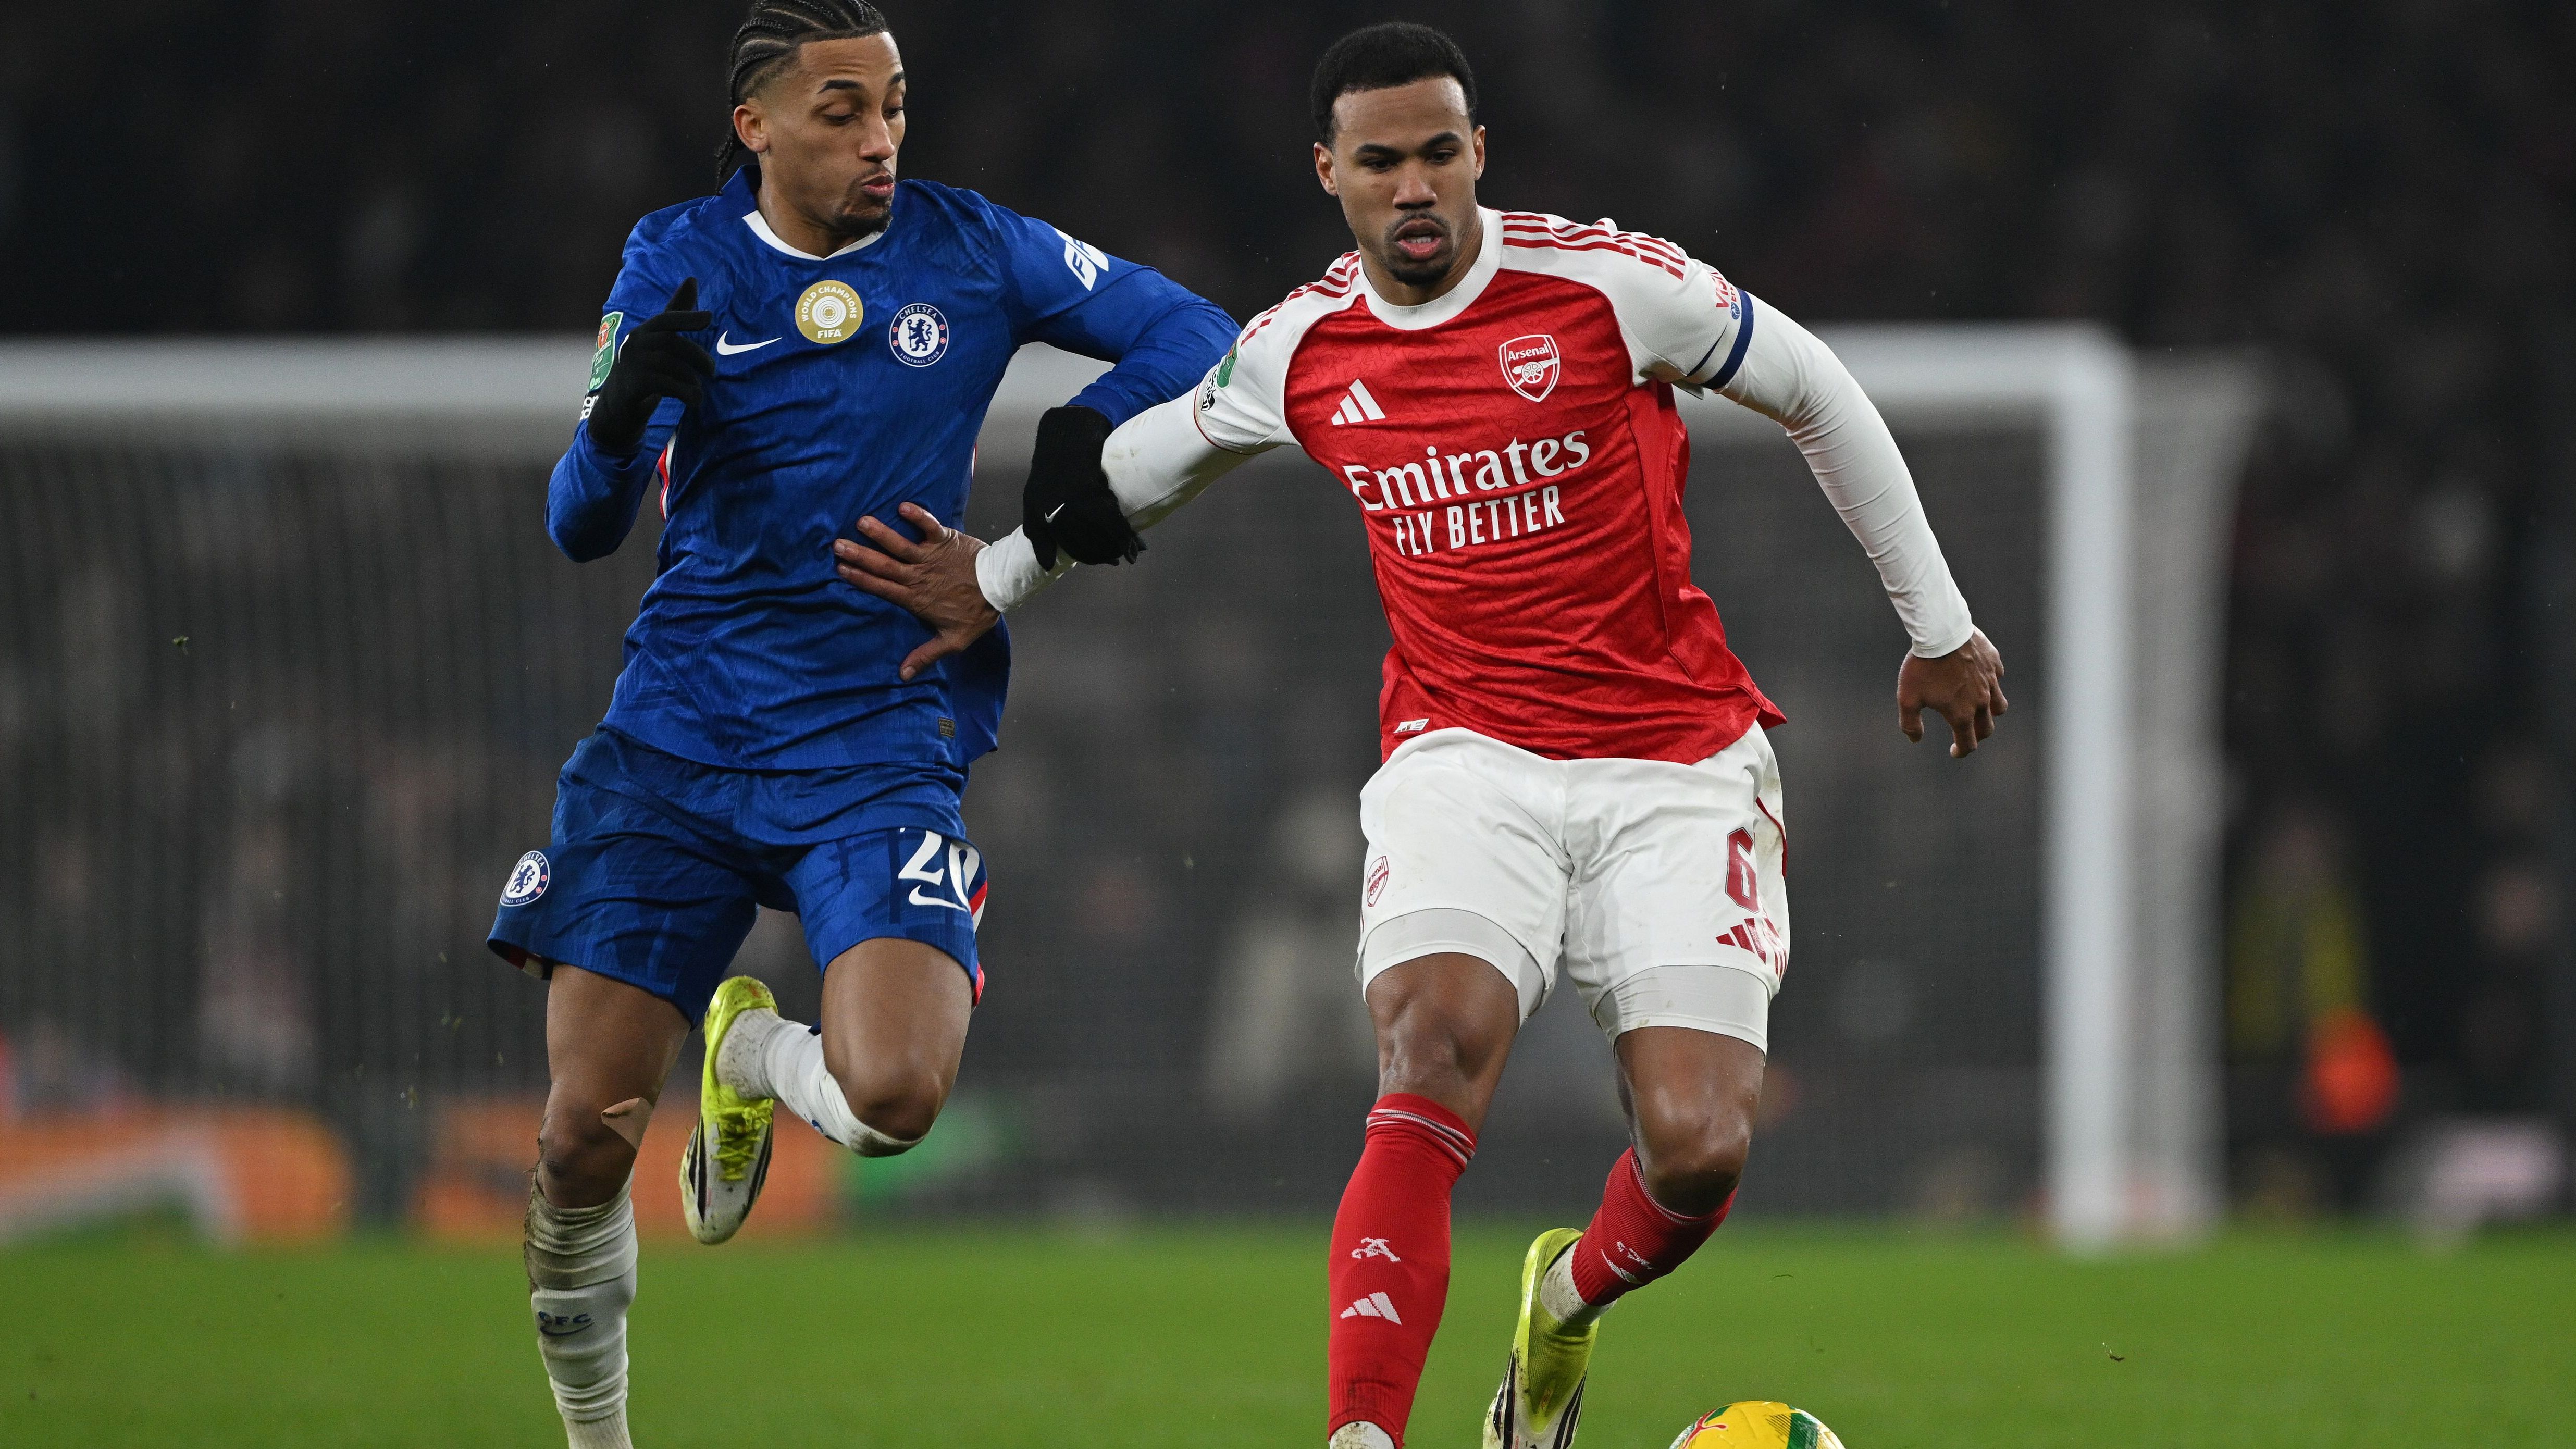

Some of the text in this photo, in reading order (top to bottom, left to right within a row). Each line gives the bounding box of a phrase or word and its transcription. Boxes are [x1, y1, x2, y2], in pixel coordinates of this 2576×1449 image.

[802, 286, 857, 321] WORLD CHAMPIONS
[899, 306, 938, 320] CHELSEA
[818, 329, 843, 339] FIFA
[900, 351, 940, 364] FOOTBALL CLUB
[1508, 343, 1550, 362] Arsenal
[1342, 430, 1590, 511] Emirates
[1393, 485, 1565, 556] FLY BETTER
[898, 827, 981, 912] 20
[1725, 827, 1760, 914] 6
